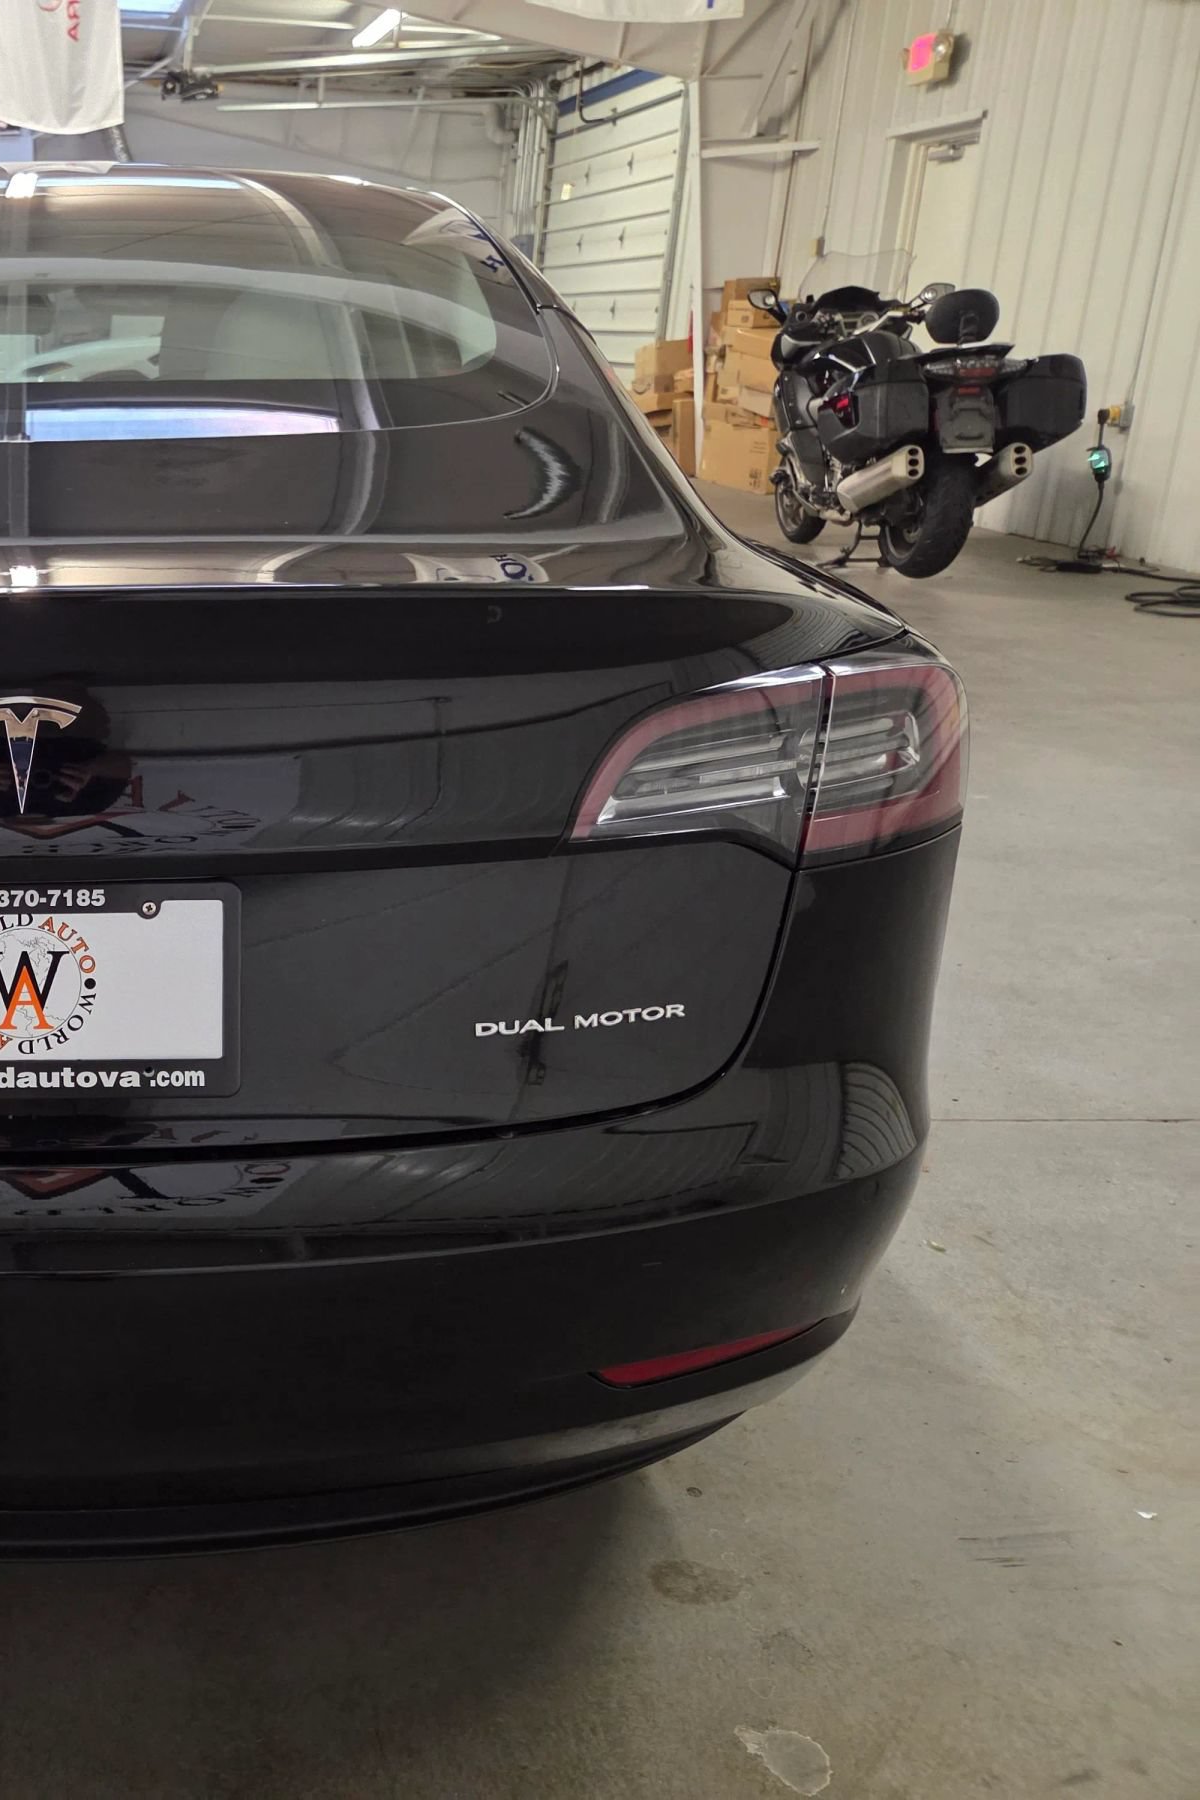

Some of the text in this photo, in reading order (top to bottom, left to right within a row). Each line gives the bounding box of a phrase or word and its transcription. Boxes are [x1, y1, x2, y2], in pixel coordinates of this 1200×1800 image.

[38, 916, 96, 973] AUTO
[18, 992, 96, 1054] WORLD
[475, 1003, 686, 1037] DUAL MOTOR
